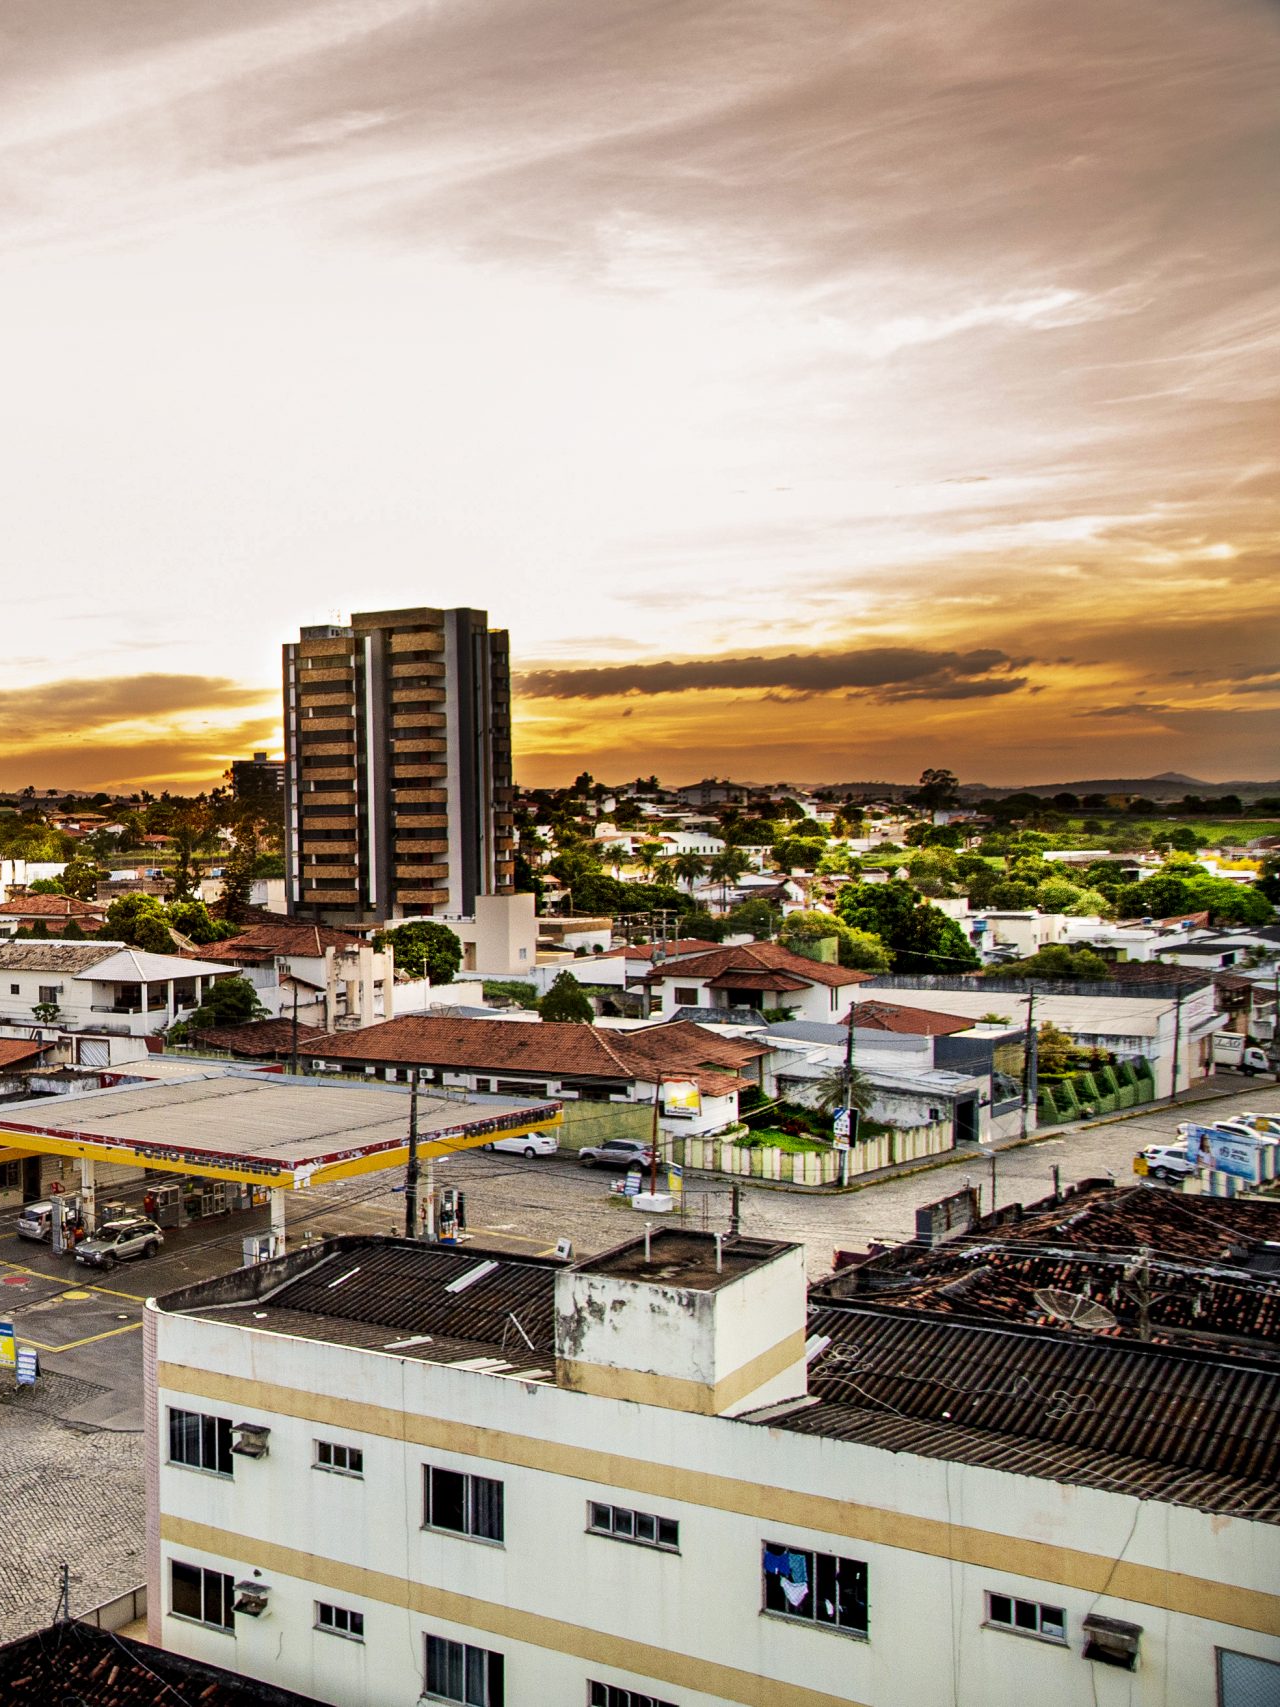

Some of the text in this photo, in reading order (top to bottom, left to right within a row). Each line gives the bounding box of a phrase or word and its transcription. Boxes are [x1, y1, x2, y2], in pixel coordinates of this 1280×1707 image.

[464, 1120, 496, 1139] POSTO
[135, 1145, 281, 1177] POSTO ELEFANTINHO
